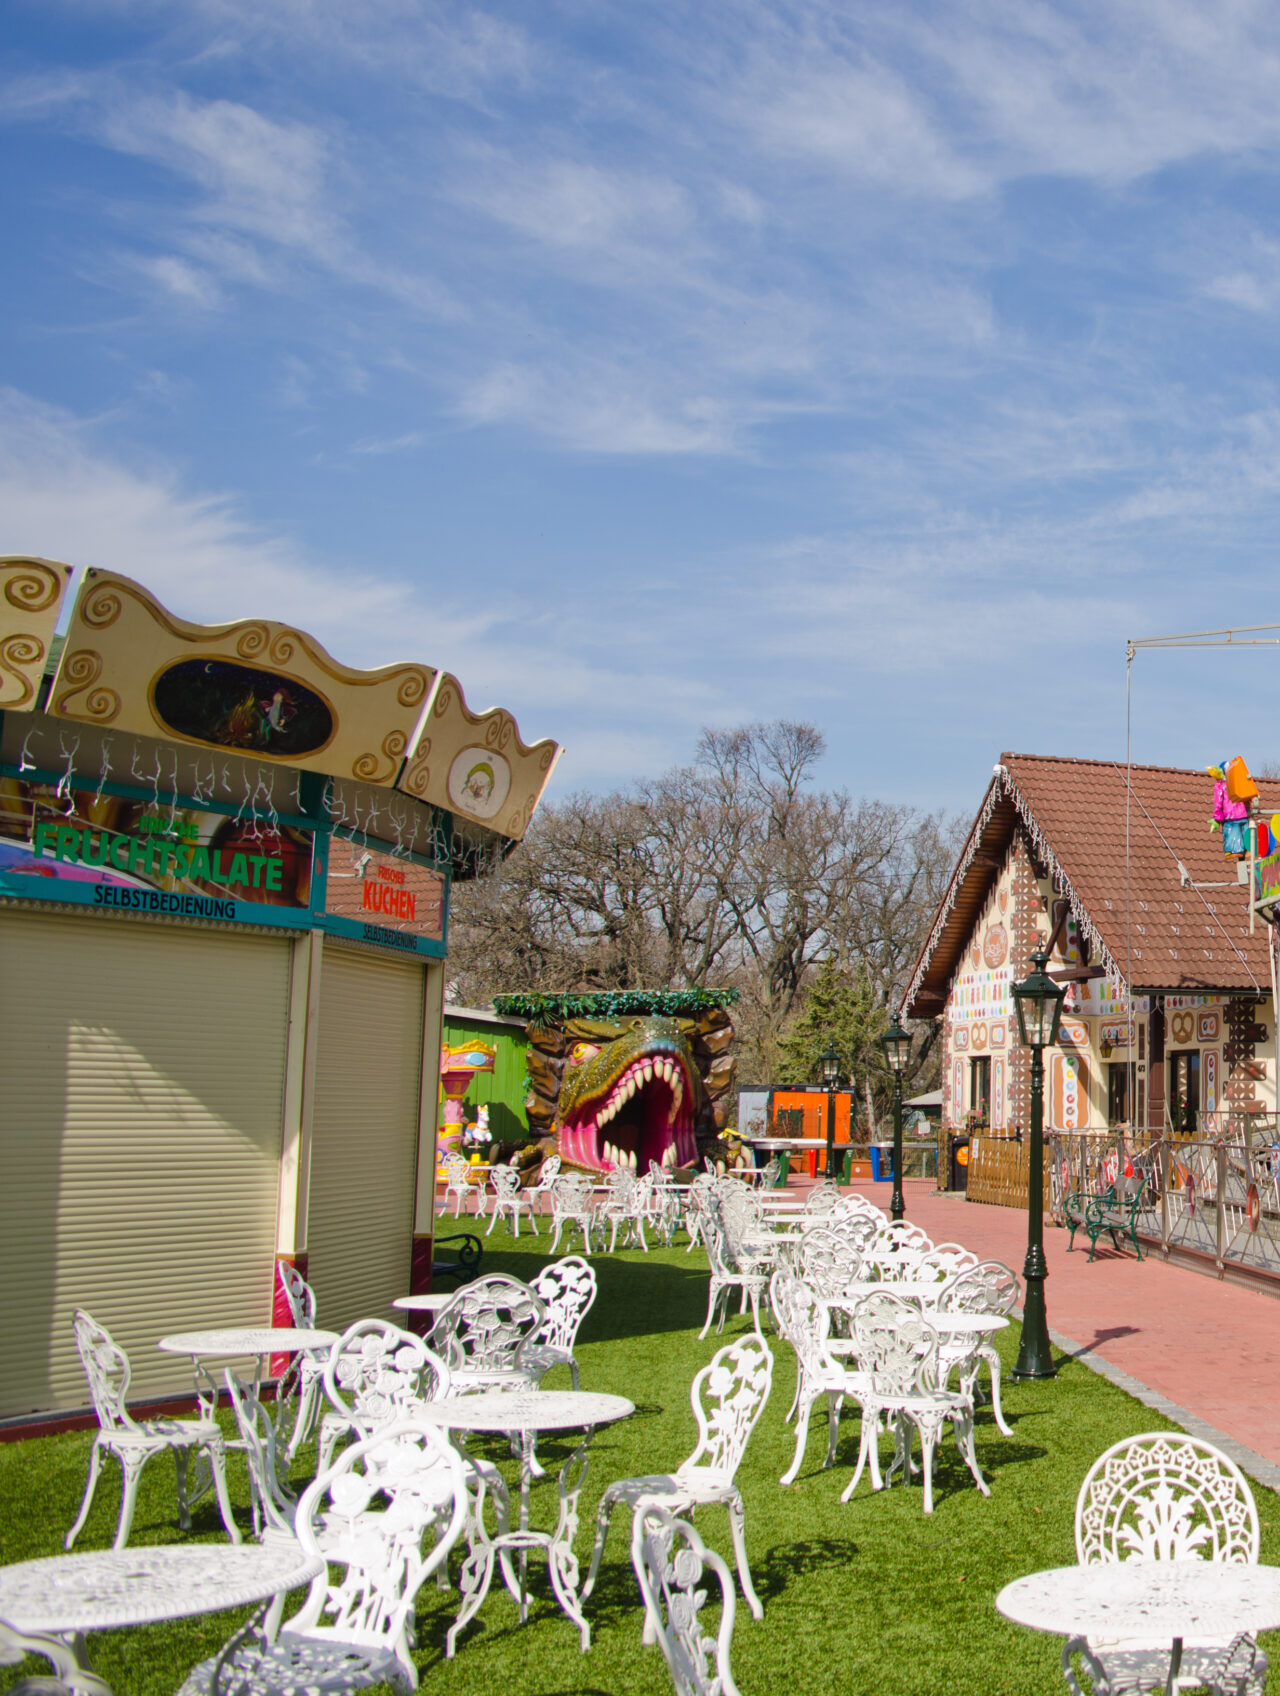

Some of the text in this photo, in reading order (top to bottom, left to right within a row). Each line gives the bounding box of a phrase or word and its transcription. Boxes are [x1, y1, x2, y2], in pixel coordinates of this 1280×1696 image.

[139, 815, 199, 841] FRISCHE
[33, 823, 283, 891] FRUCHTSALATE
[94, 885, 236, 919] SELBSTBEDIENUNG
[363, 880, 416, 921] KUCHEN
[363, 923, 418, 950] SELBSTBEDIENUNG
